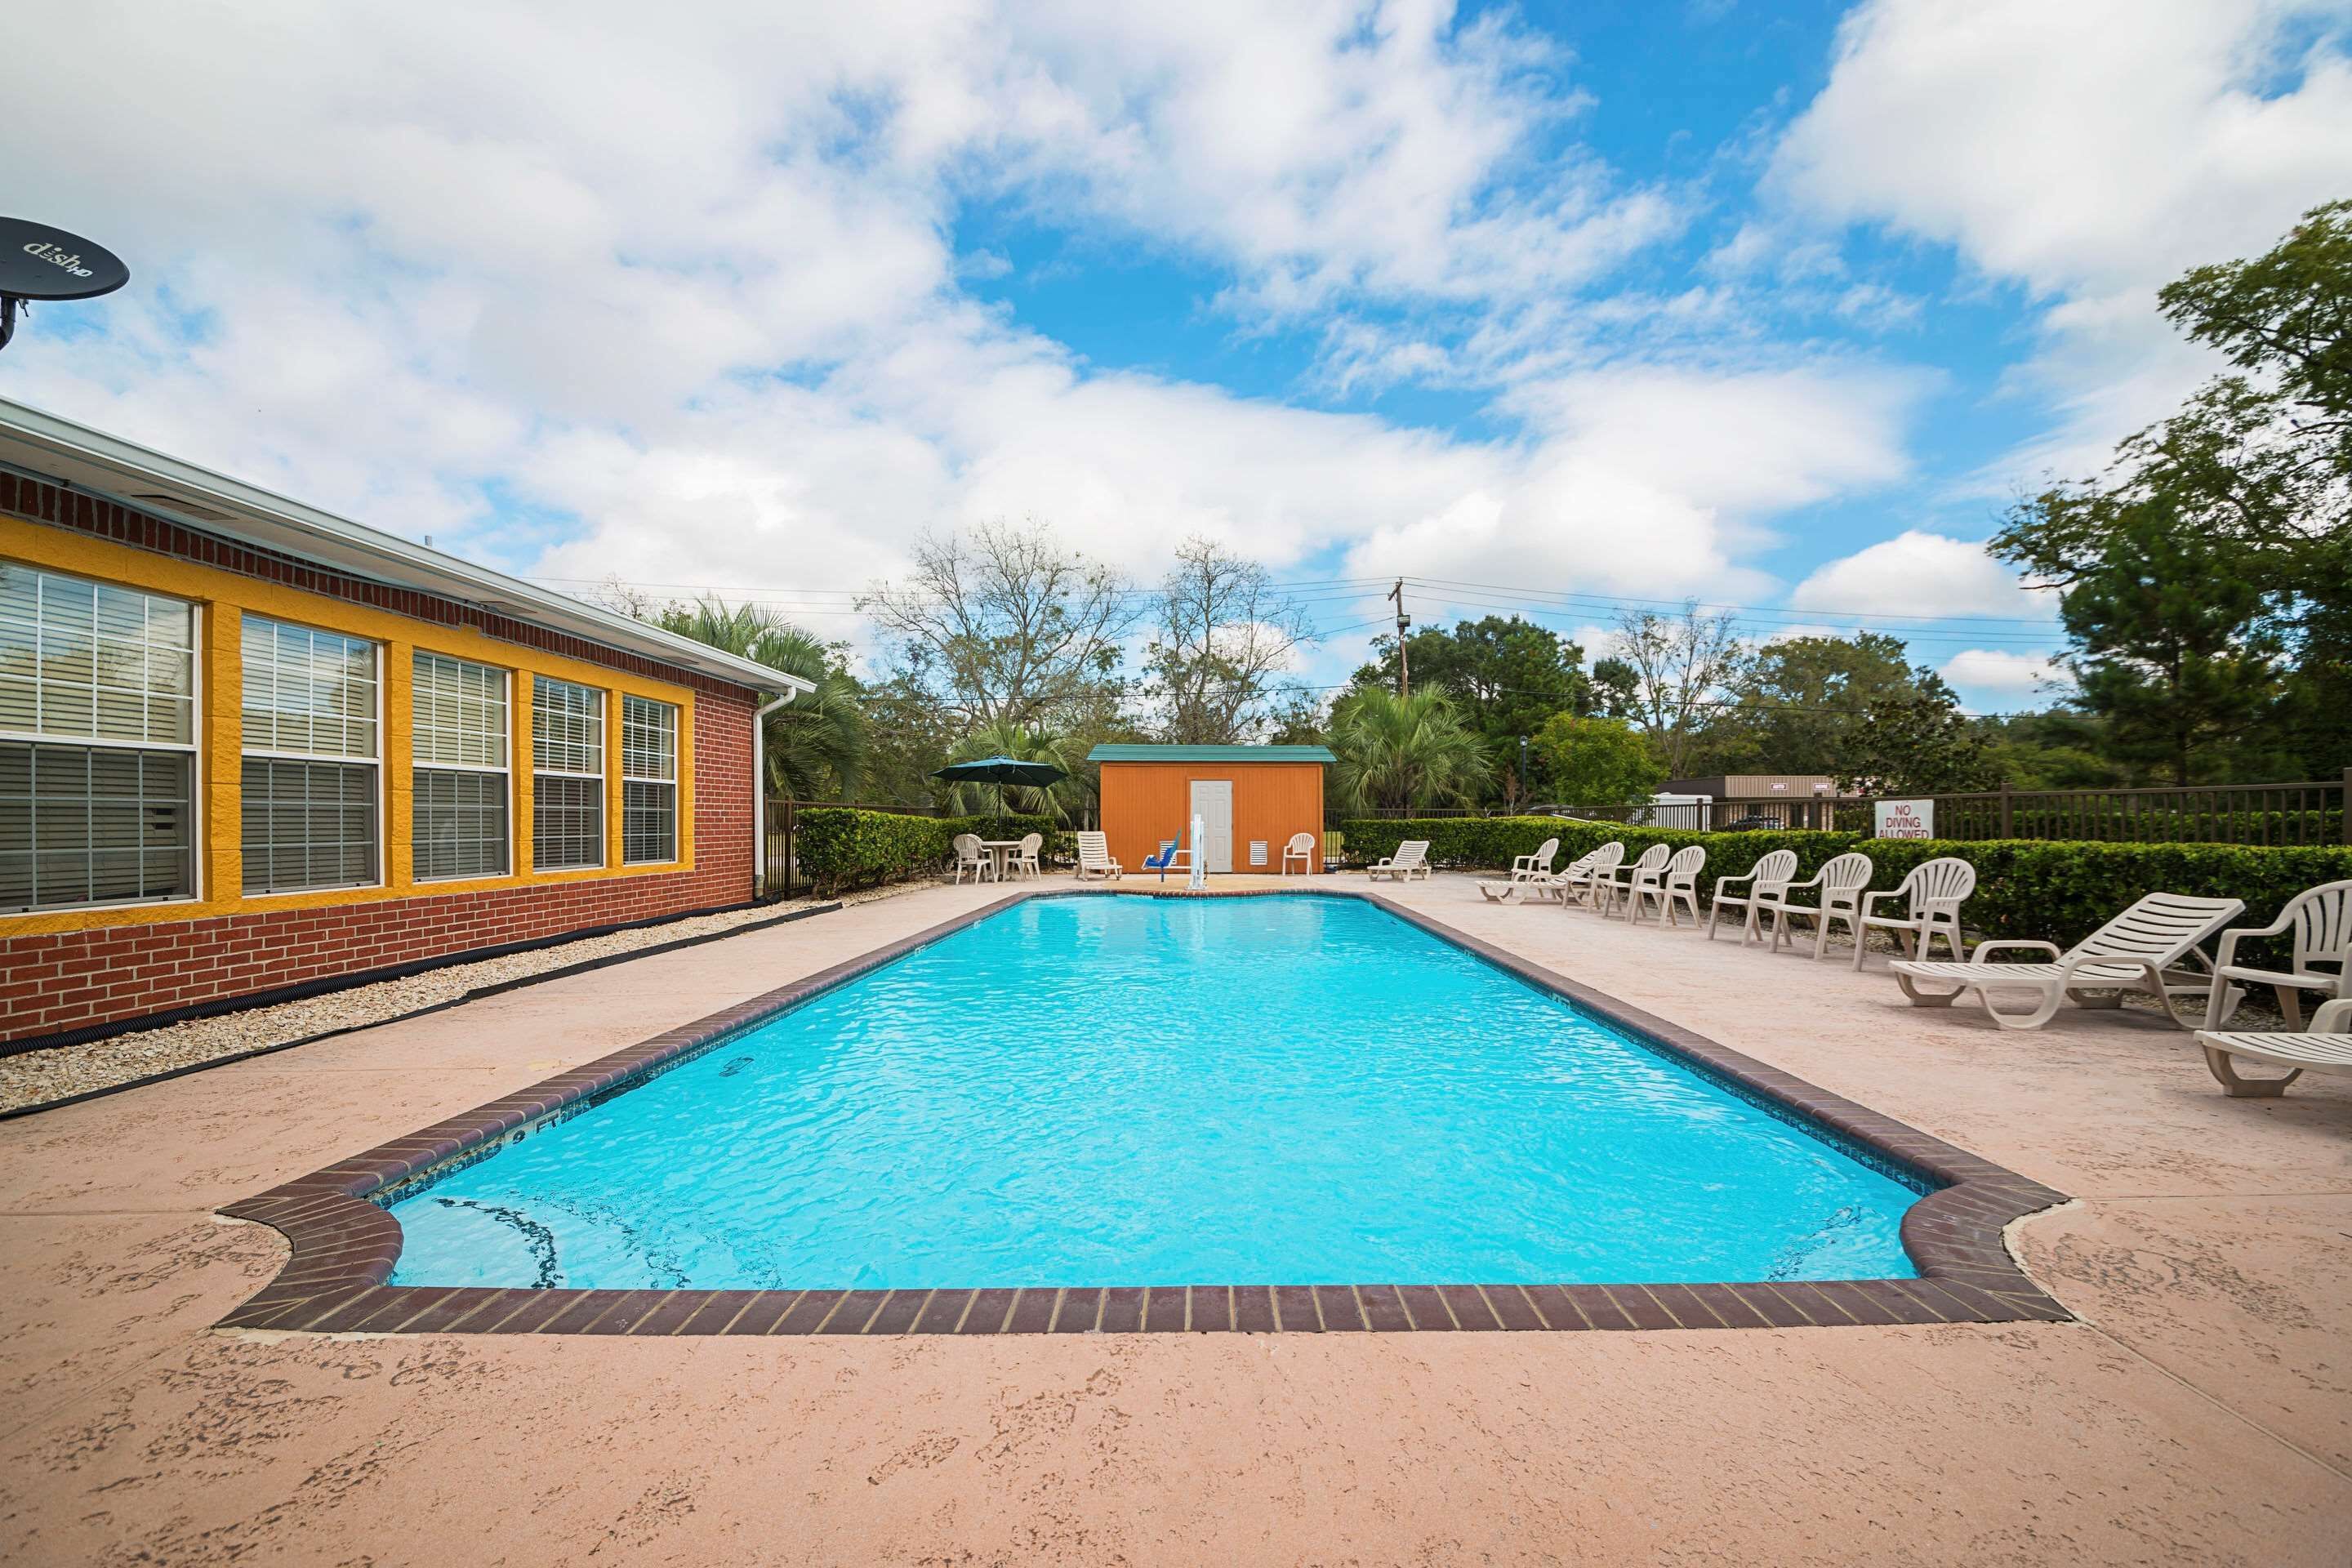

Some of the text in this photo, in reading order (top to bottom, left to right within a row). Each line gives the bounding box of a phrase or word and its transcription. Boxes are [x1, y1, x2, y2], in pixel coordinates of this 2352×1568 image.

[1895, 804, 1911, 816] NO
[1886, 817, 1921, 828] DIVING
[1878, 829, 1930, 840] ALLOWED
